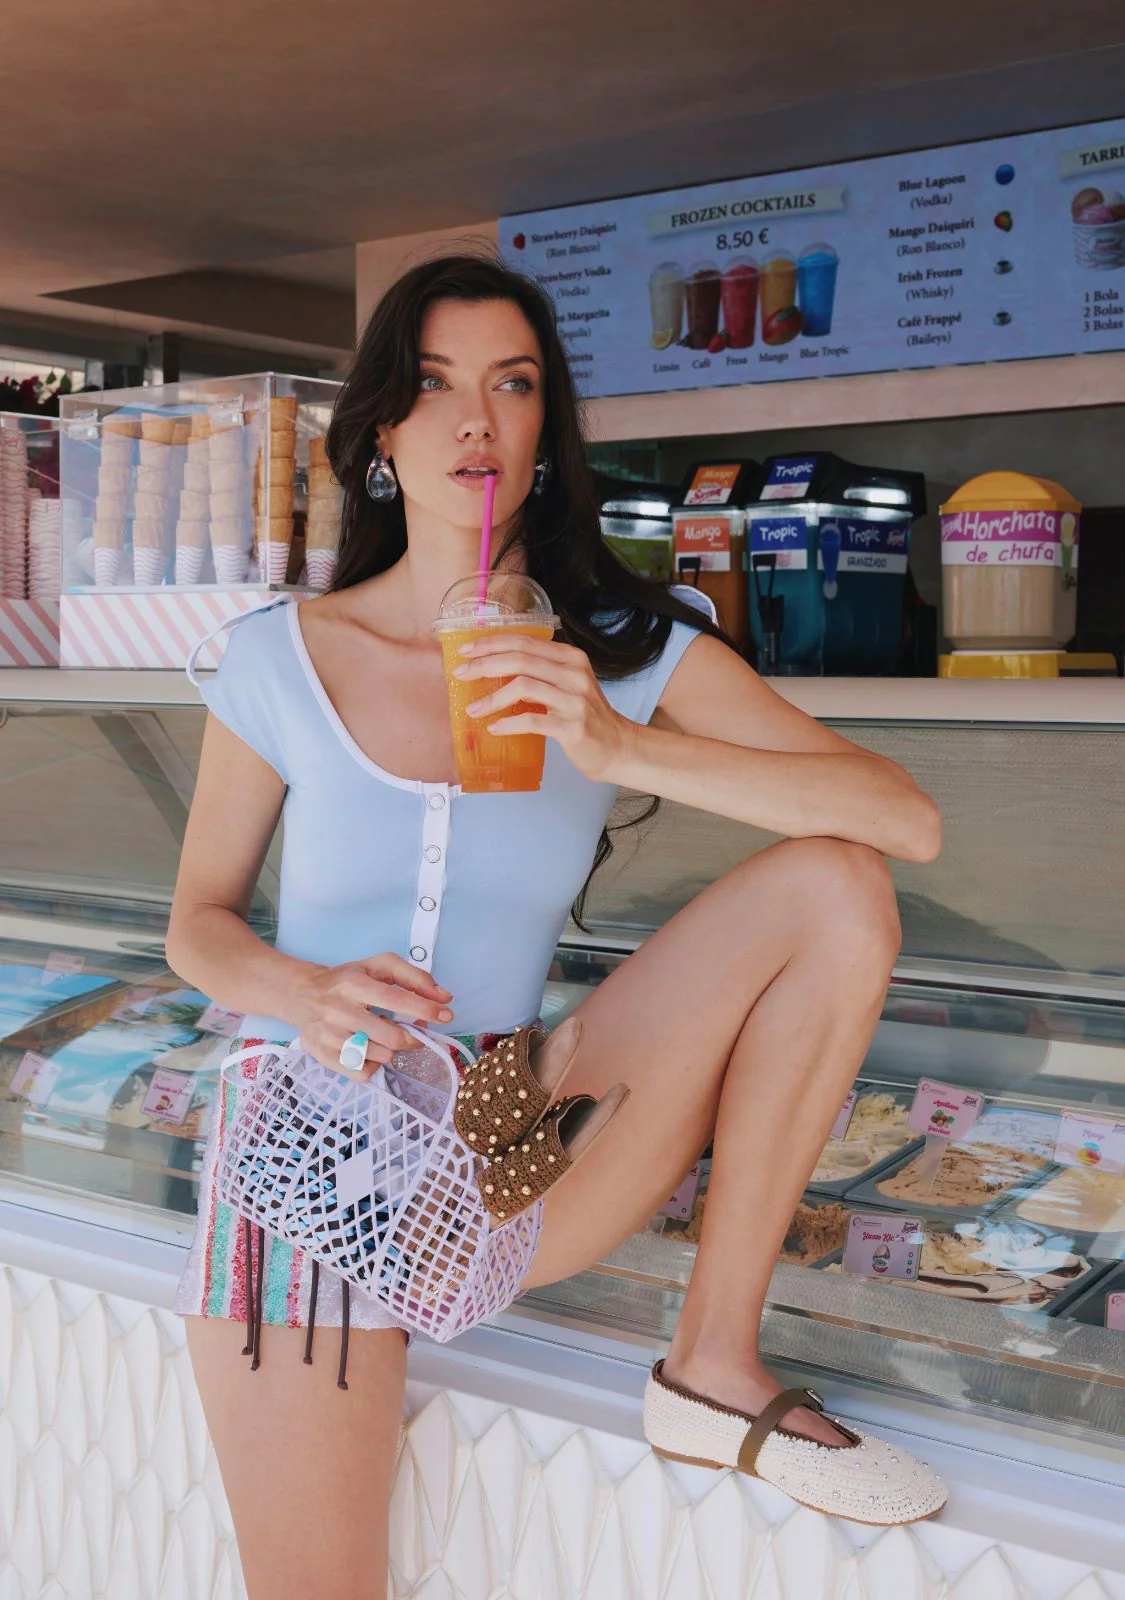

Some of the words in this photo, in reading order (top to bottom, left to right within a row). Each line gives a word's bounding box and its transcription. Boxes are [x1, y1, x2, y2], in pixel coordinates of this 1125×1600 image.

[898, 180, 923, 192] Blue
[925, 174, 966, 189] Lagoon
[910, 193, 953, 210] (Vodka)
[671, 203, 728, 228] FROZEN
[731, 193, 816, 216] COCKTAILS
[531, 229, 578, 243] Strawberry
[579, 222, 617, 237] Daiquiri
[758, 227, 769, 245] €
[888, 226, 925, 239] Mango
[928, 217, 975, 234] Daiquiri
[546, 247, 567, 259] (Ron
[569, 242, 601, 256] Blanco)
[897, 244, 922, 258] (Ron
[925, 237, 966, 253] Blanco)
[584, 265, 612, 277] Vodka
[898, 270, 923, 283] Irish
[926, 268, 963, 279] Frozen
[556, 286, 590, 298] (Vodka)
[906, 285, 954, 302] (Whisky)
[1084, 292, 1090, 303] 1
[1094, 288, 1119, 302] Bola
[567, 308, 610, 322] Margarita
[1084, 306, 1090, 318] 2
[1094, 303, 1124, 317] Bolas
[897, 315, 921, 328] Café
[925, 311, 962, 327] Frappé
[1084, 321, 1090, 333] 3
[1094, 318, 1124, 331] Bolas
[906, 331, 951, 347] (Baileys)
[759, 352, 789, 364] Mango
[801, 348, 819, 358] Blue
[823, 345, 850, 357] Tropic
[776, 463, 814, 478] Tropic
[684, 525, 722, 542] Mango
[760, 524, 798, 542] Tropic
[963, 511, 1056, 540] Horchata
[847, 526, 880, 547] Tropic
[966, 544, 988, 563] de
[998, 542, 1054, 561] chufa
